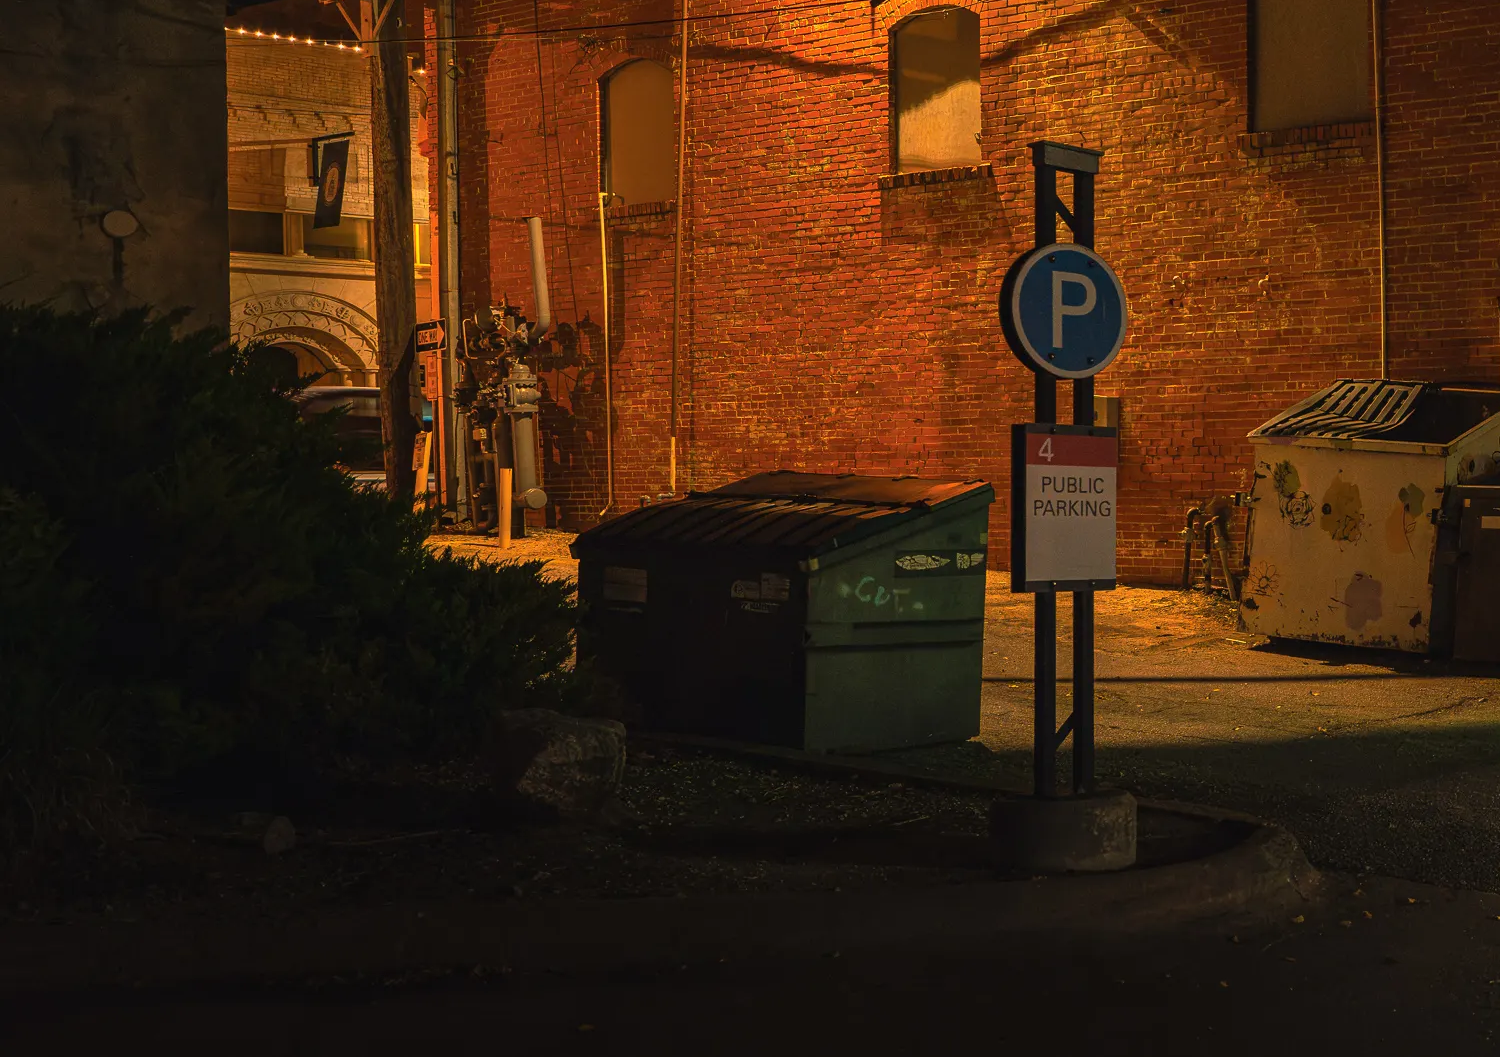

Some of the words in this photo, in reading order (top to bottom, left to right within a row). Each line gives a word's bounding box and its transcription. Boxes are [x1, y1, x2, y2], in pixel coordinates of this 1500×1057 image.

[1052, 270, 1097, 348] P
[418, 330, 428, 344] ONE
[1038, 437, 1054, 462] 4
[1041, 476, 1105, 494] PUBLIC
[1033, 499, 1111, 517] PARKING
